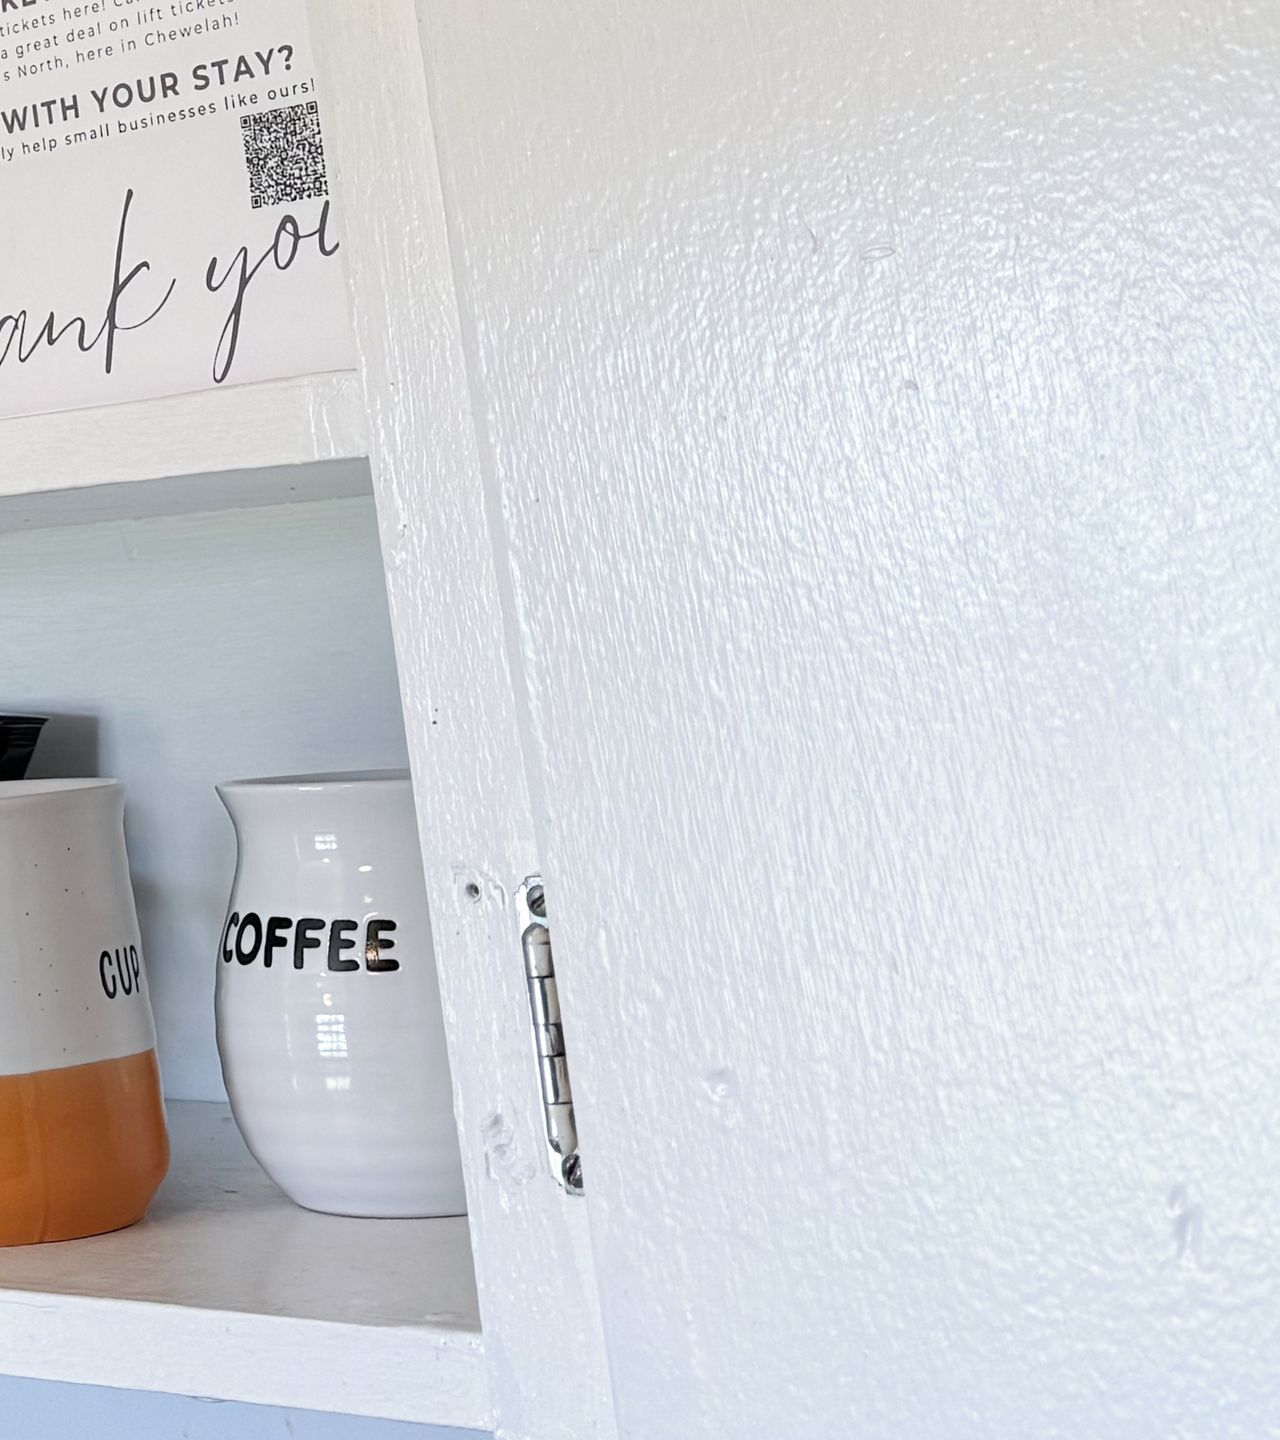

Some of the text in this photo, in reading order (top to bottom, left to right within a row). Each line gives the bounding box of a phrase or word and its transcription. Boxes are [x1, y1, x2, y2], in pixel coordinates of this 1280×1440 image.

[0, 48, 9, 60] a
[14, 34, 59, 60] great
[64, 21, 102, 43] deal
[107, 17, 130, 32] on
[136, 7, 163, 26] lift
[16, 55, 69, 79] North,
[74, 45, 114, 63] here
[119, 39, 137, 53] in
[143, 11, 239, 47] Chewelah!
[0, 93, 80, 135] WITH
[88, 71, 180, 114] YOUR
[190, 44, 294, 91] STAY?
[20, 137, 58, 155] help
[63, 122, 110, 146] small
[116, 102, 217, 134] businesses
[222, 93, 259, 111] like
[265, 77, 315, 101] ours!
[99, 945, 139, 1000] CUP
[223, 912, 400, 972] COFFEE
